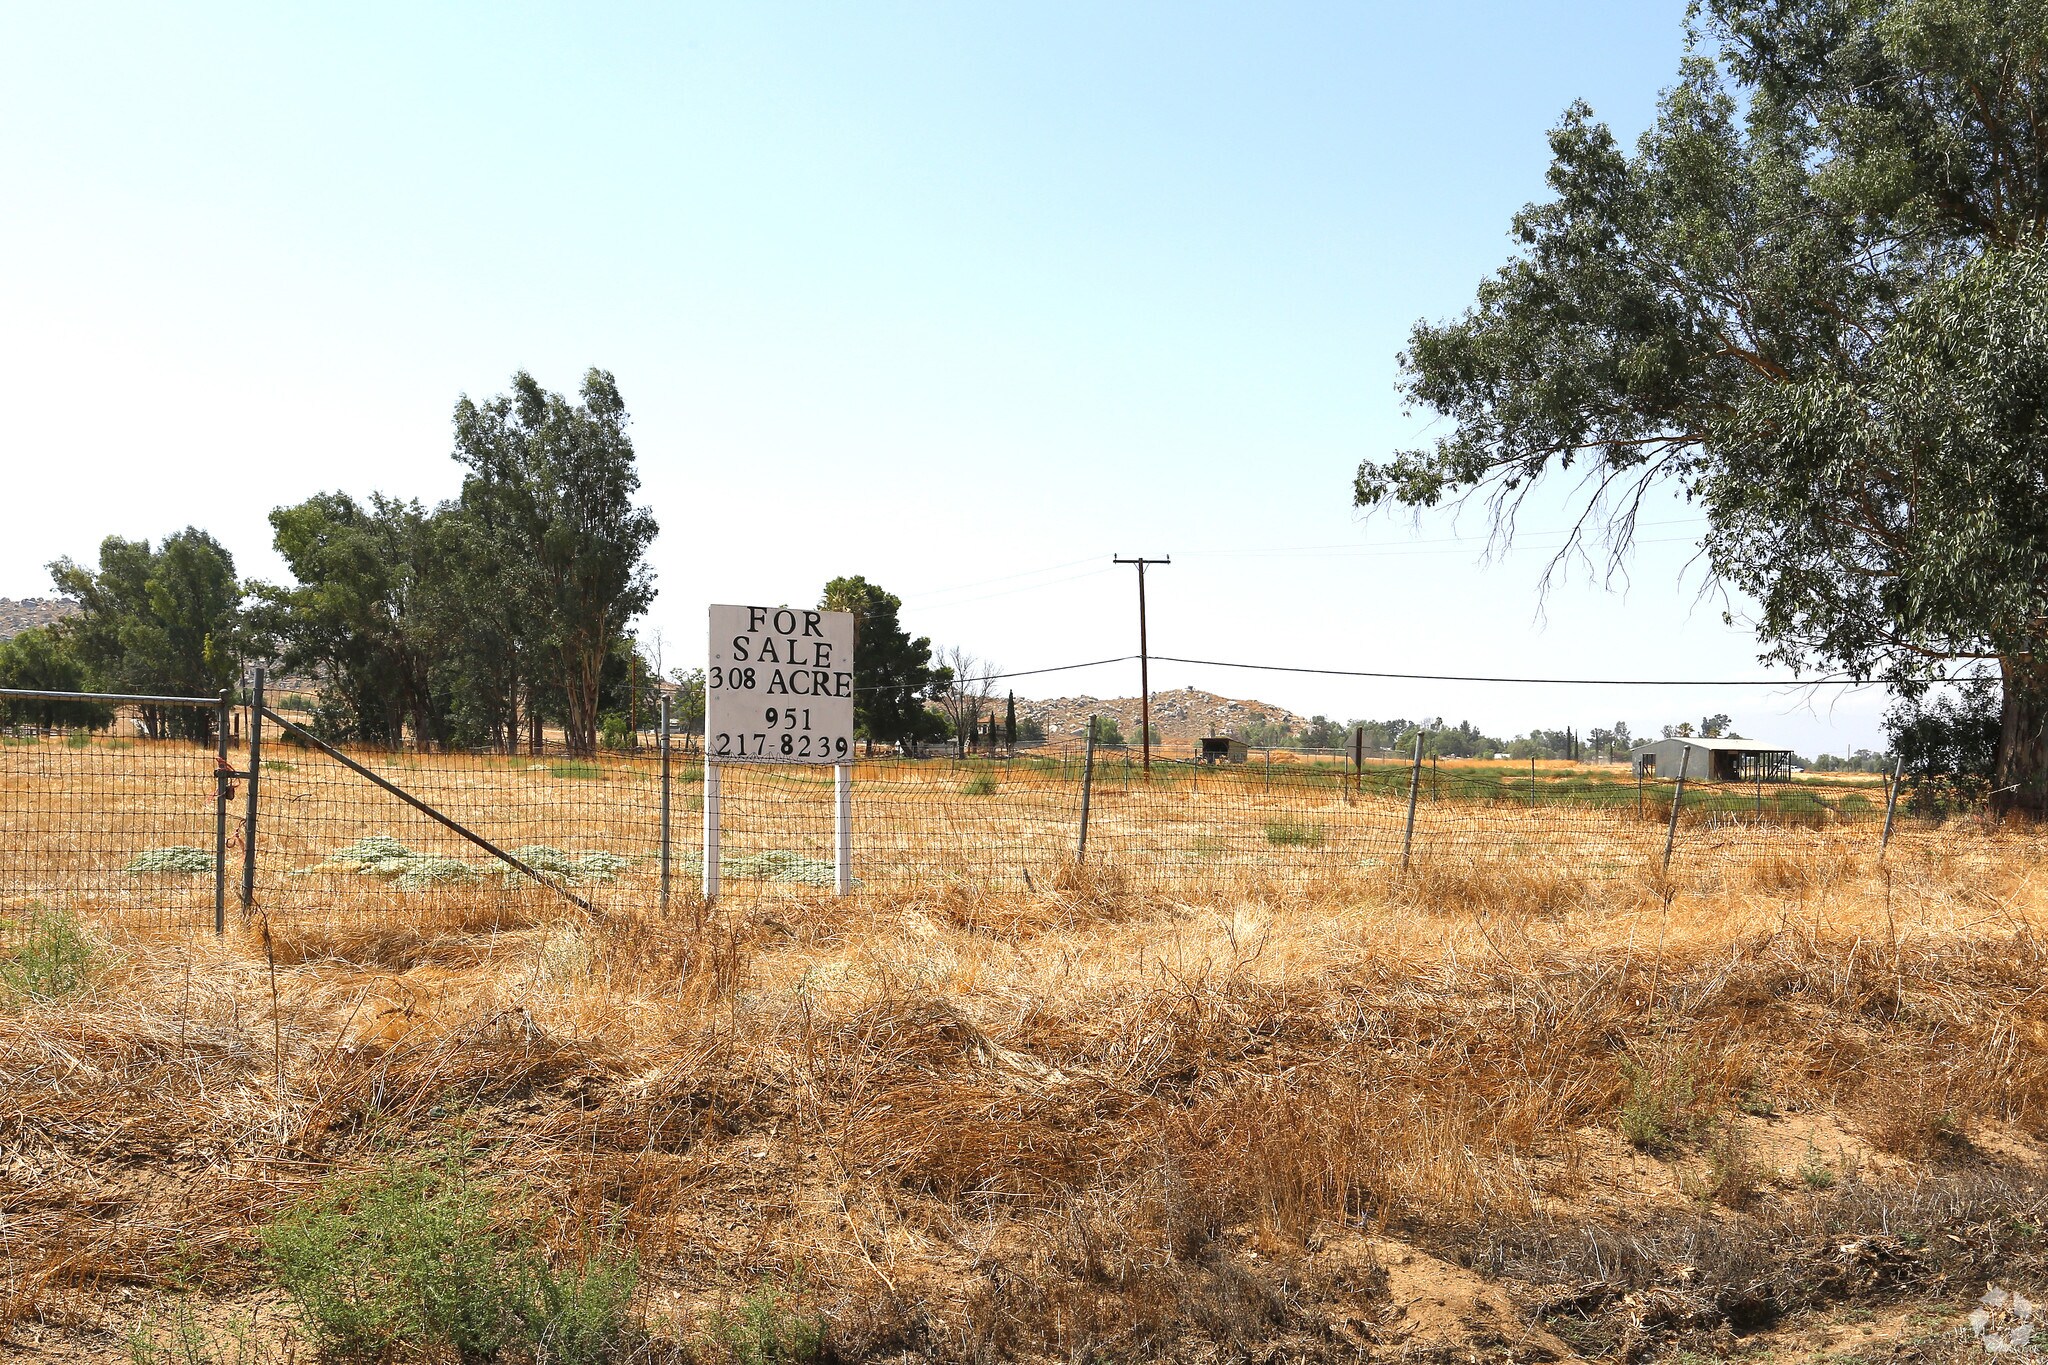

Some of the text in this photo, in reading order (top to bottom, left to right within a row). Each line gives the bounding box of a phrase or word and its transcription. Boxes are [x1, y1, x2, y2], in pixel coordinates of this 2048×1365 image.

[747, 606, 823, 637] FOR
[733, 636, 832, 668] SALE
[709, 666, 852, 697] 3.08 ACRE
[765, 707, 811, 730] 951
[717, 733, 848, 758] 217-8239
